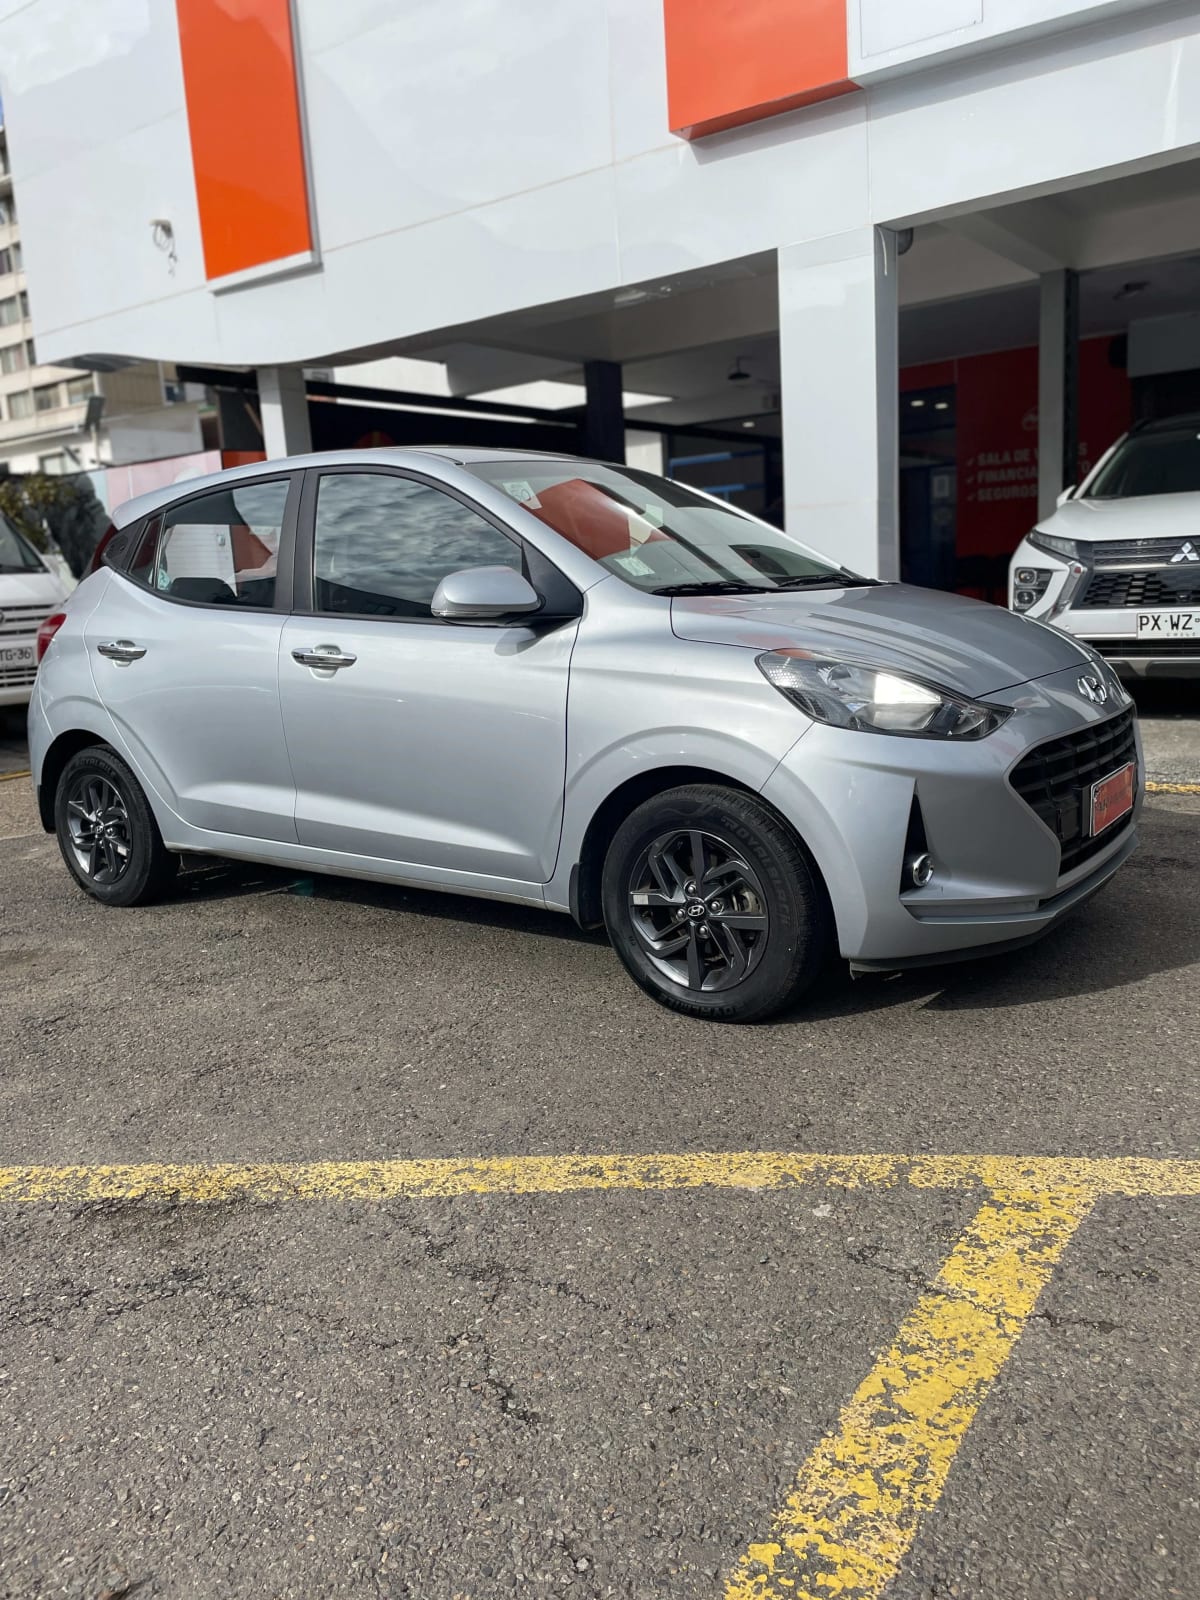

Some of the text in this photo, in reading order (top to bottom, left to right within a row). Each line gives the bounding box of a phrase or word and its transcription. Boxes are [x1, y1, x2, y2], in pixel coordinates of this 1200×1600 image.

[977, 451, 1011, 466] SALA
[1013, 448, 1030, 463] DE
[977, 484, 1038, 502] SEGUROS
